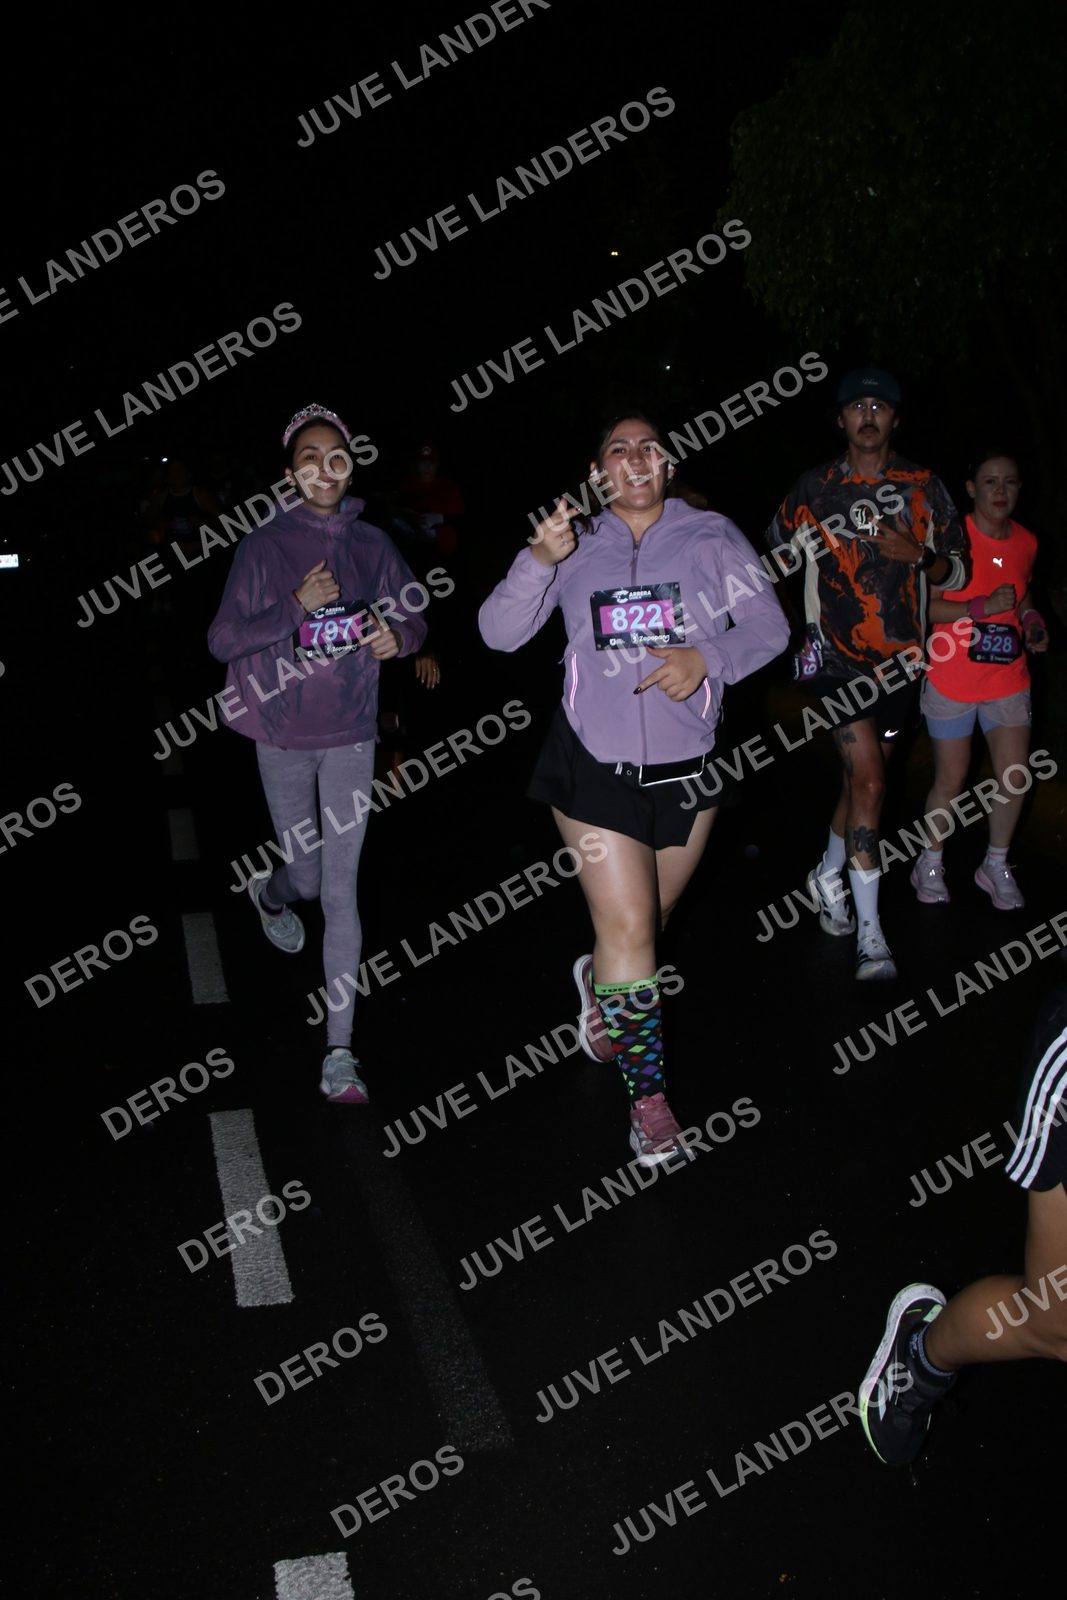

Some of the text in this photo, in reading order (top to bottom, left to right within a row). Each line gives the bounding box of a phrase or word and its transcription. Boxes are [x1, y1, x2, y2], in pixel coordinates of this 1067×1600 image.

[309, 617, 353, 642] 797
[611, 603, 664, 631] 822
[981, 635, 1012, 653] 528
